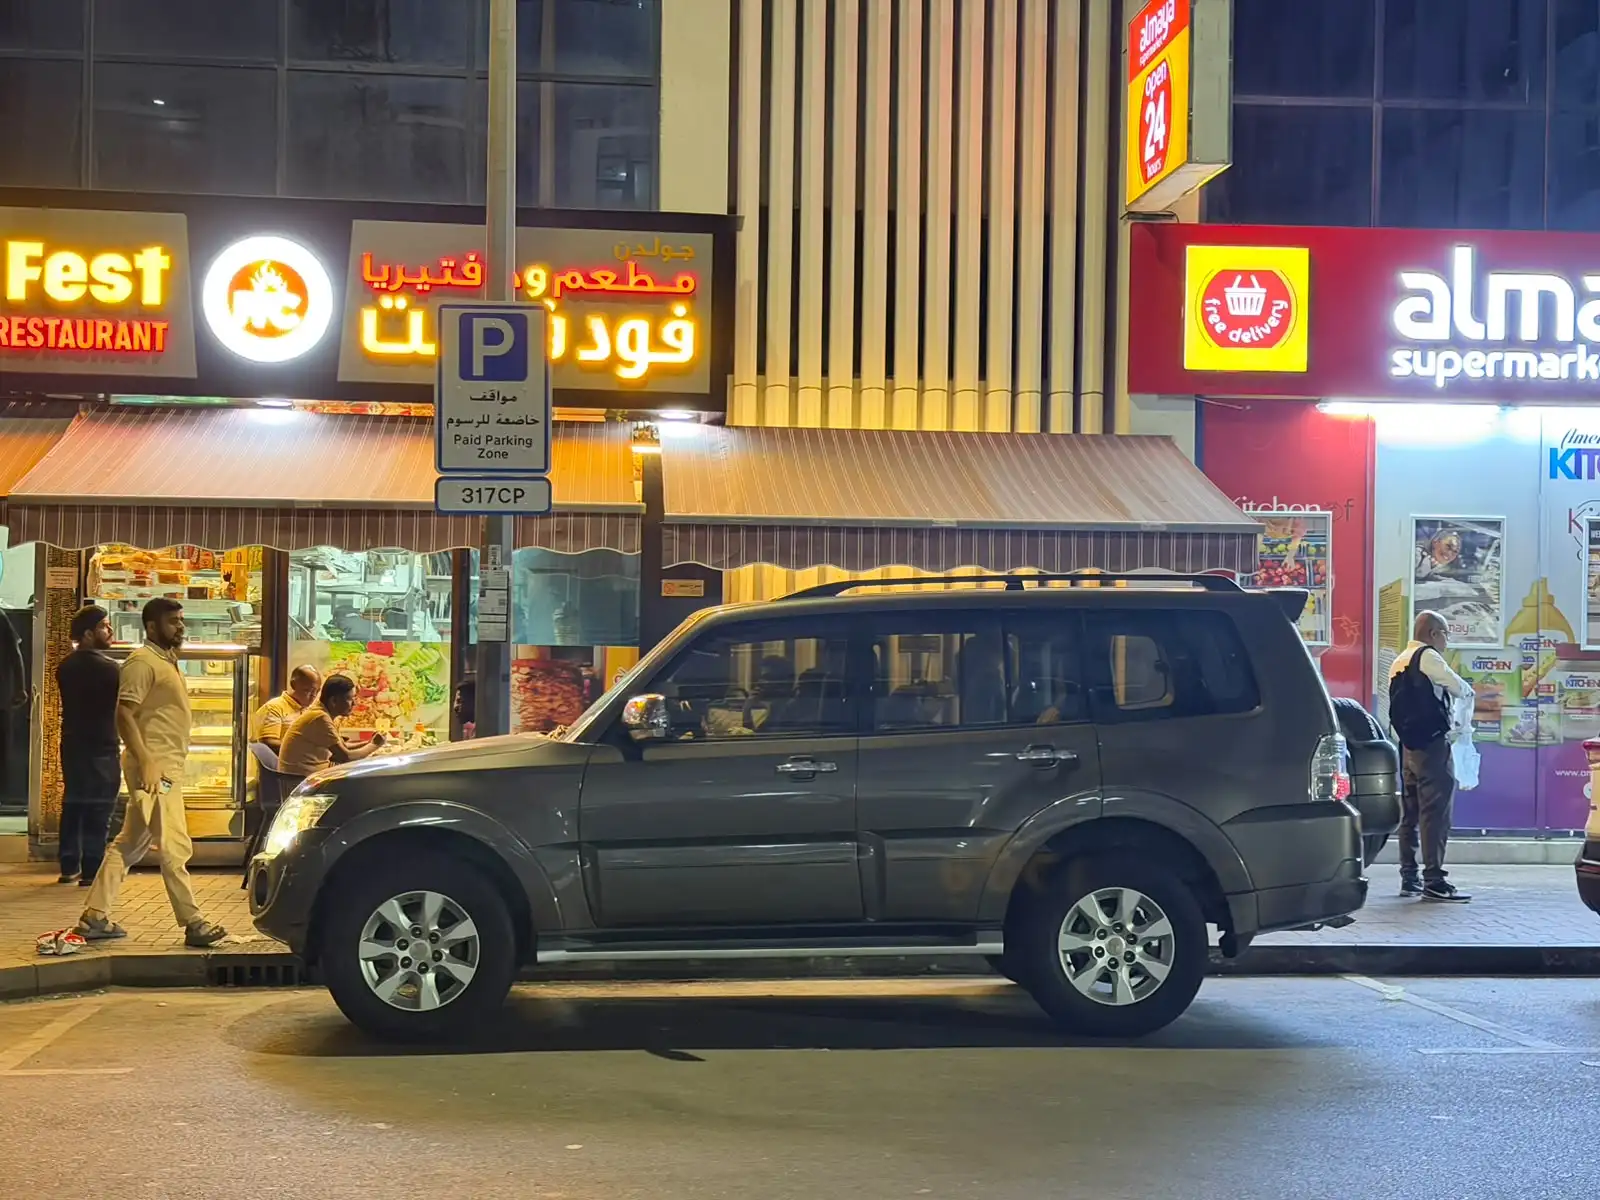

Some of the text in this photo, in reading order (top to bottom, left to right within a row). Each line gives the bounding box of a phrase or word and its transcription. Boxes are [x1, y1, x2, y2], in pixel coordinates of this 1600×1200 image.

[1140, 0, 1175, 52] almaya
[1145, 61, 1167, 98] open
[1144, 90, 1166, 162] 24
[1147, 158, 1162, 179] hours
[613, 236, 695, 262] جولدن
[6, 241, 170, 306] Fest
[553, 260, 697, 298] مطعم
[0, 316, 169, 352] RESTAURANT
[1205, 298, 1289, 343] free delivery
[472, 317, 515, 376] P
[1391, 344, 1600, 388] supermark
[469, 390, 518, 405] مواقف
[446, 413, 540, 430] خاضعة للرسوم
[453, 434, 533, 448] Paid Parking
[477, 448, 509, 459] Zone
[1550, 448, 1600, 480] KIT
[461, 487, 525, 504] 317CP
[1472, 660, 1512, 670] KITCHEN
